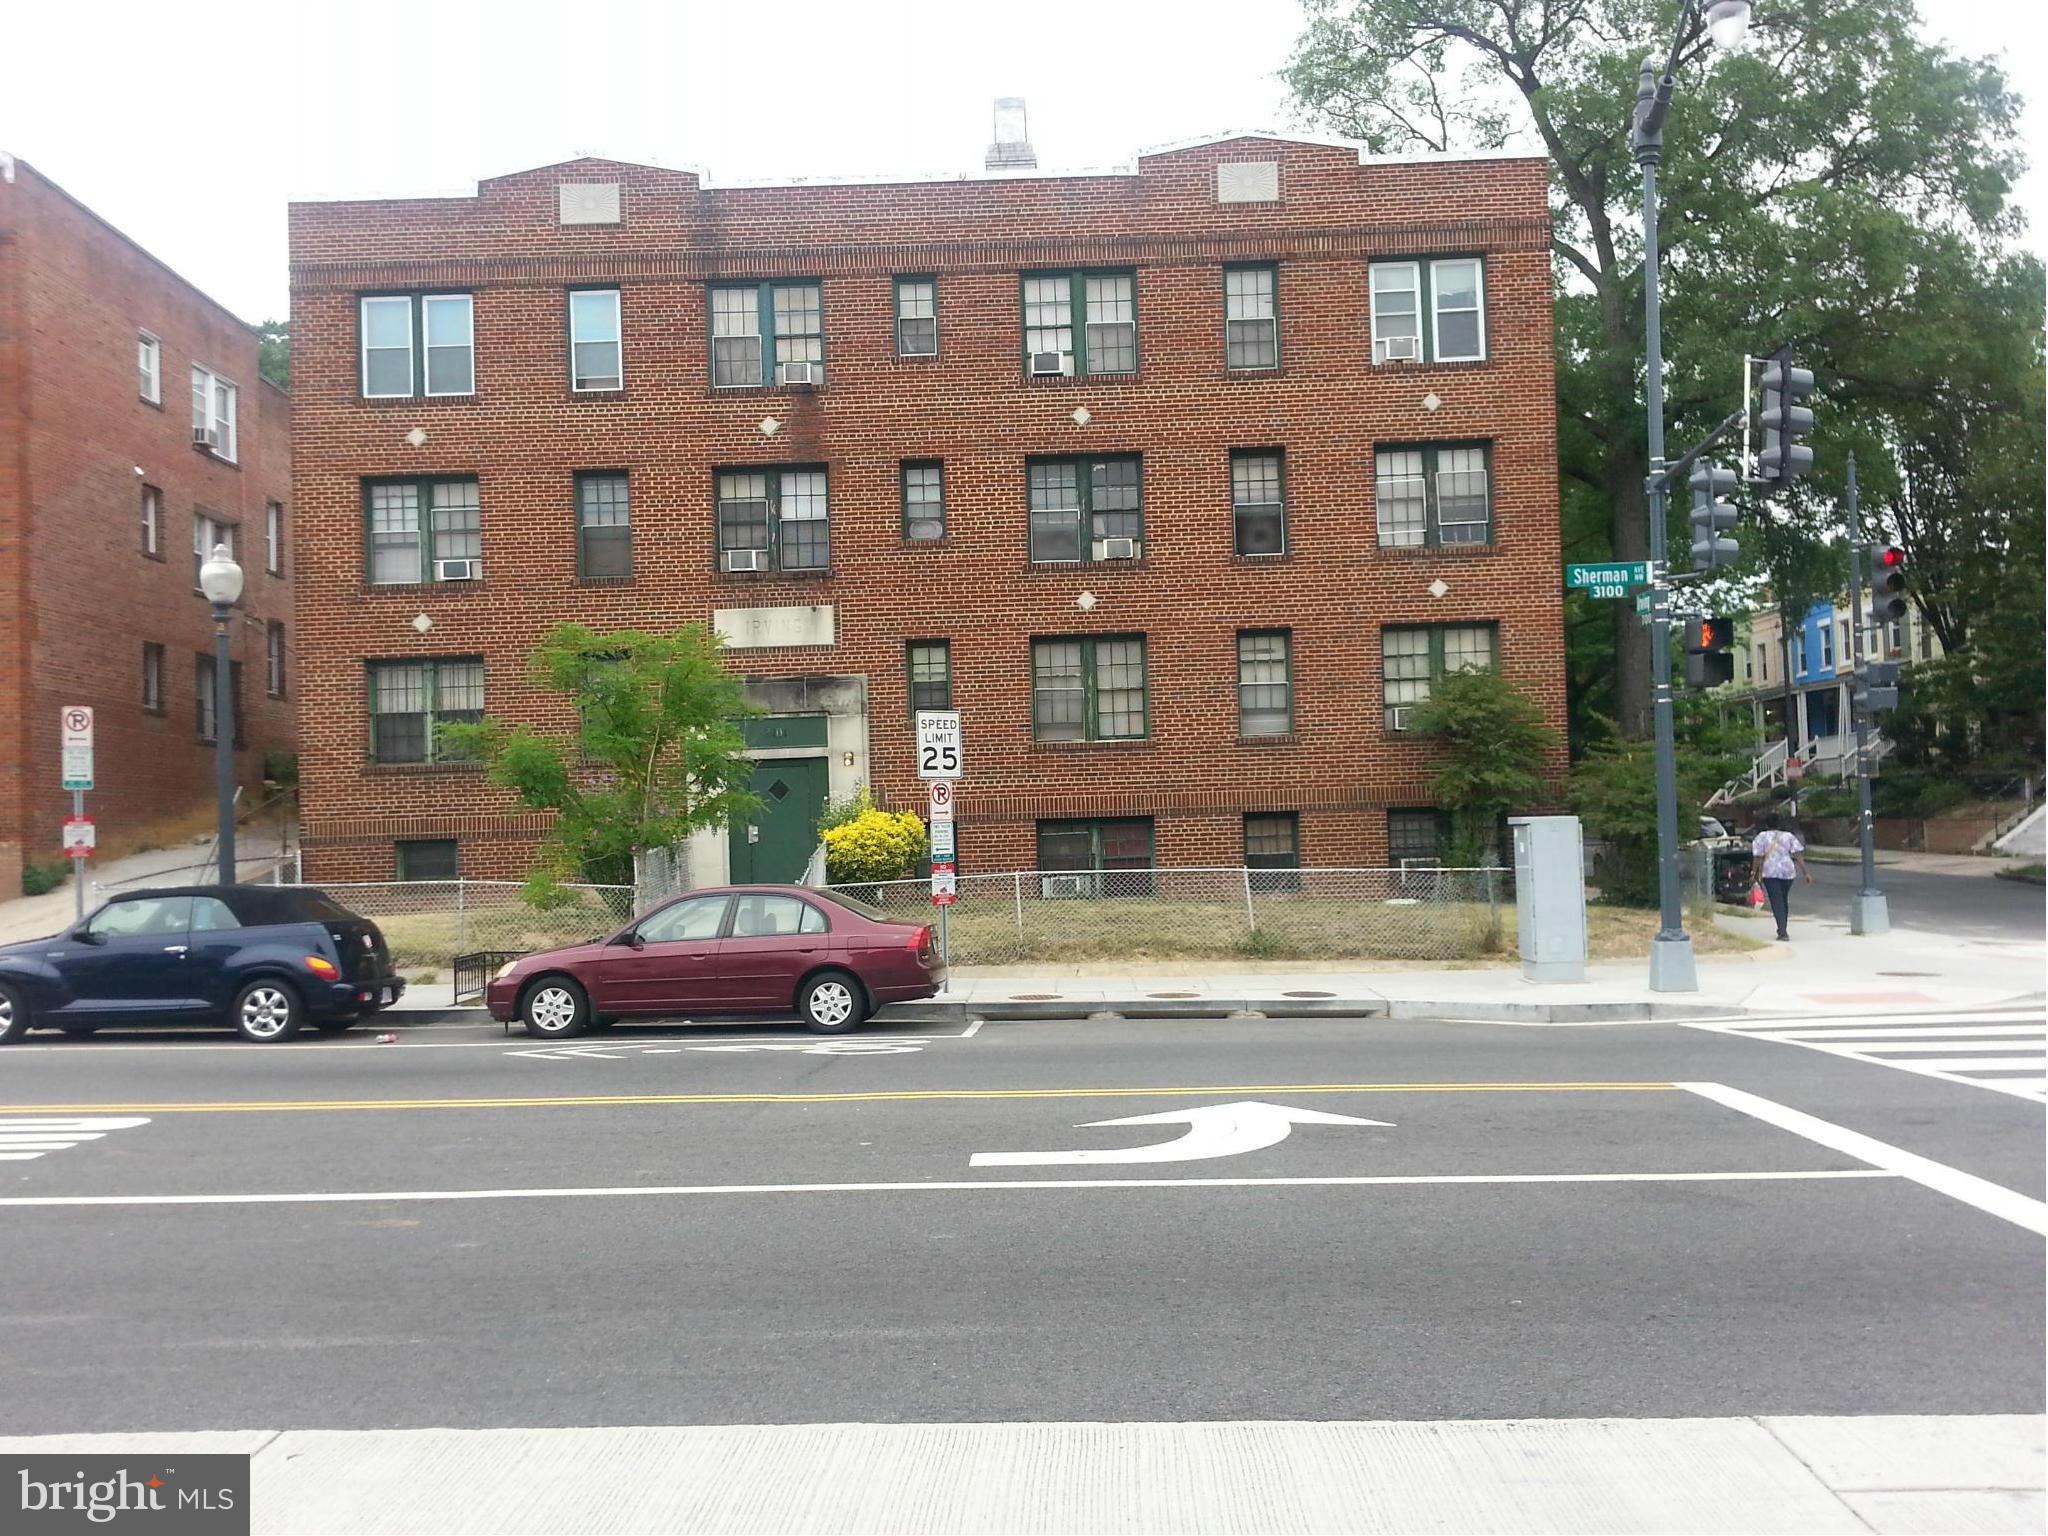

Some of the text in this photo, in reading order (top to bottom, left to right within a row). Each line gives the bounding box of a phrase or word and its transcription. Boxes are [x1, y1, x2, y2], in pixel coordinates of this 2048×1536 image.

[1634, 565, 1644, 573] AVE
[1574, 568, 1628, 584] Sherman
[1593, 585, 1624, 598] 3100
[921, 719, 957, 730] SPEED
[925, 732, 953, 744] LIMIT
[923, 746, 957, 771] 25
